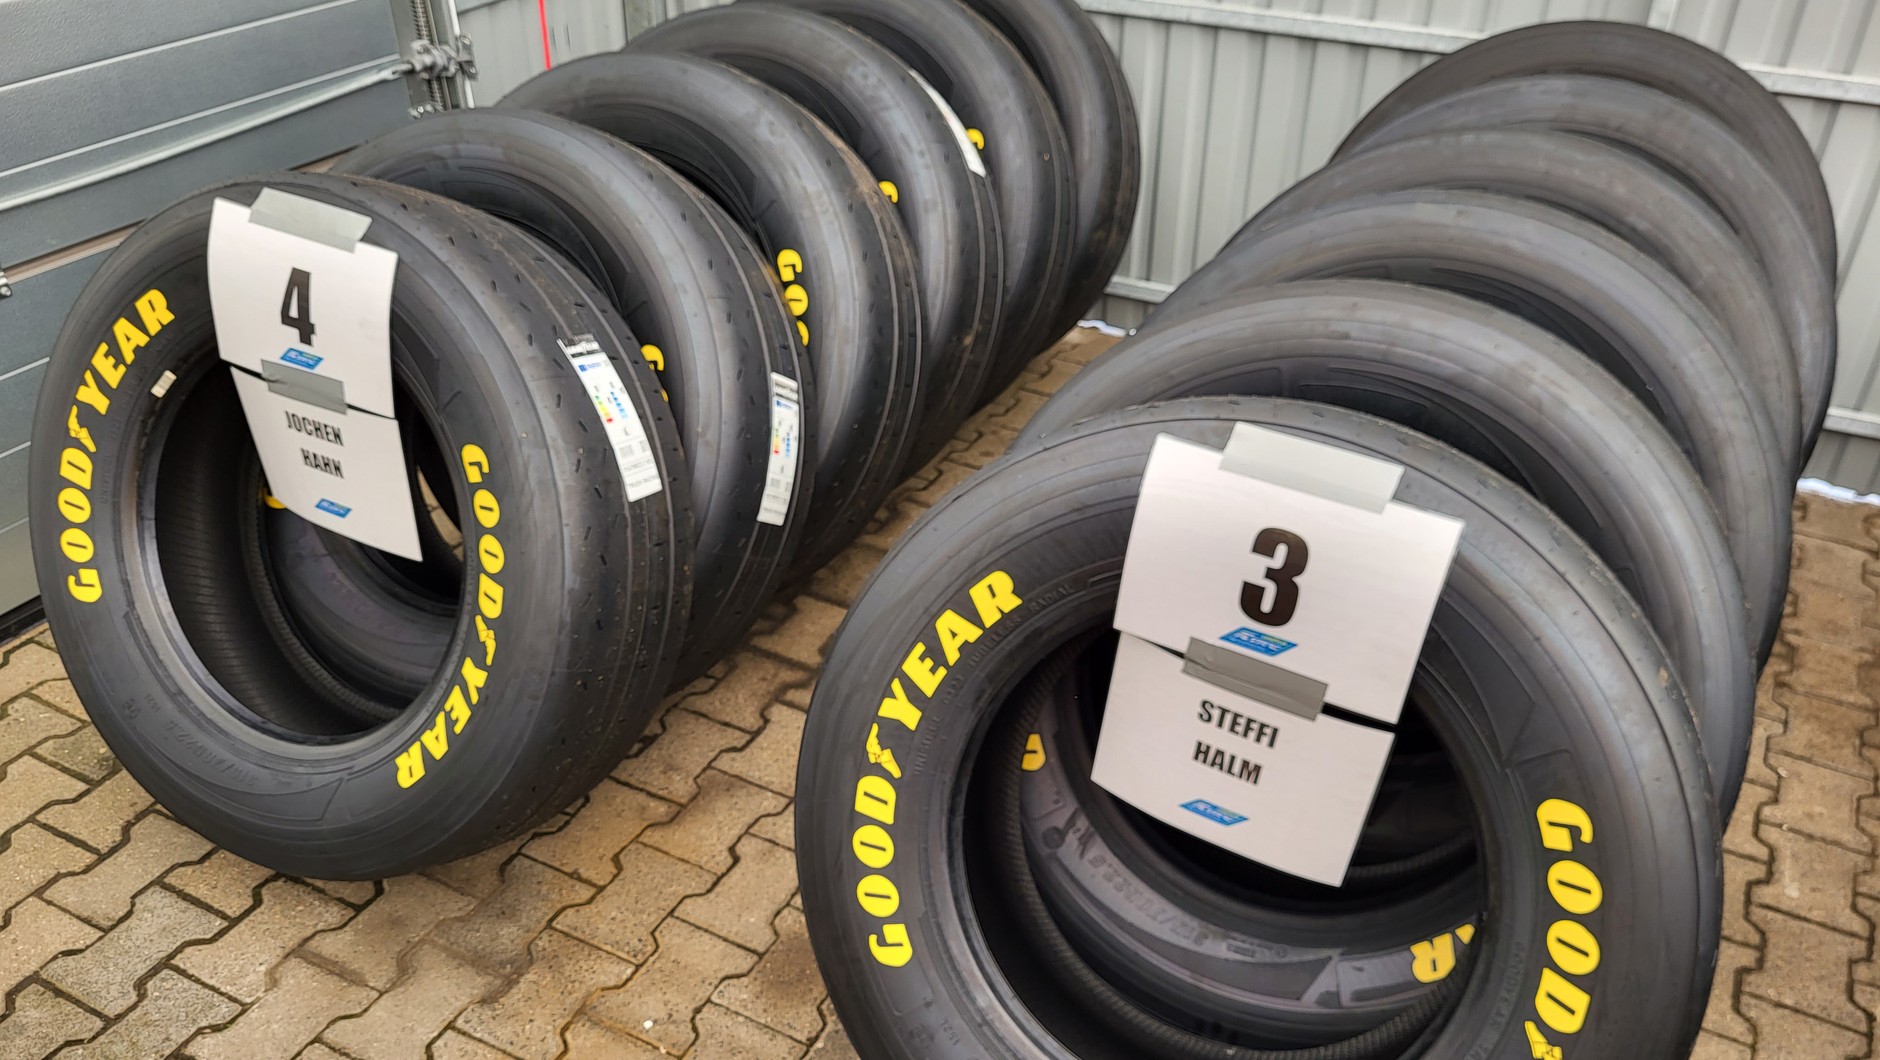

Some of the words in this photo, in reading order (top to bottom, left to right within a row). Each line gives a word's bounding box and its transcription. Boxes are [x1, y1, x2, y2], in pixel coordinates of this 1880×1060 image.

[280, 267, 316, 346] 4
[58, 287, 176, 604] GOODYEAR
[284, 409, 345, 447] JOCHEN
[300, 447, 344, 479] HAHN
[394, 443, 505, 789] GOODYEAR
[1239, 527, 1309, 626] 3
[1192, 740, 1263, 787] HALM
[1196, 698, 1280, 750] STEFFI
[852, 570, 1023, 968] GOODYEAR
